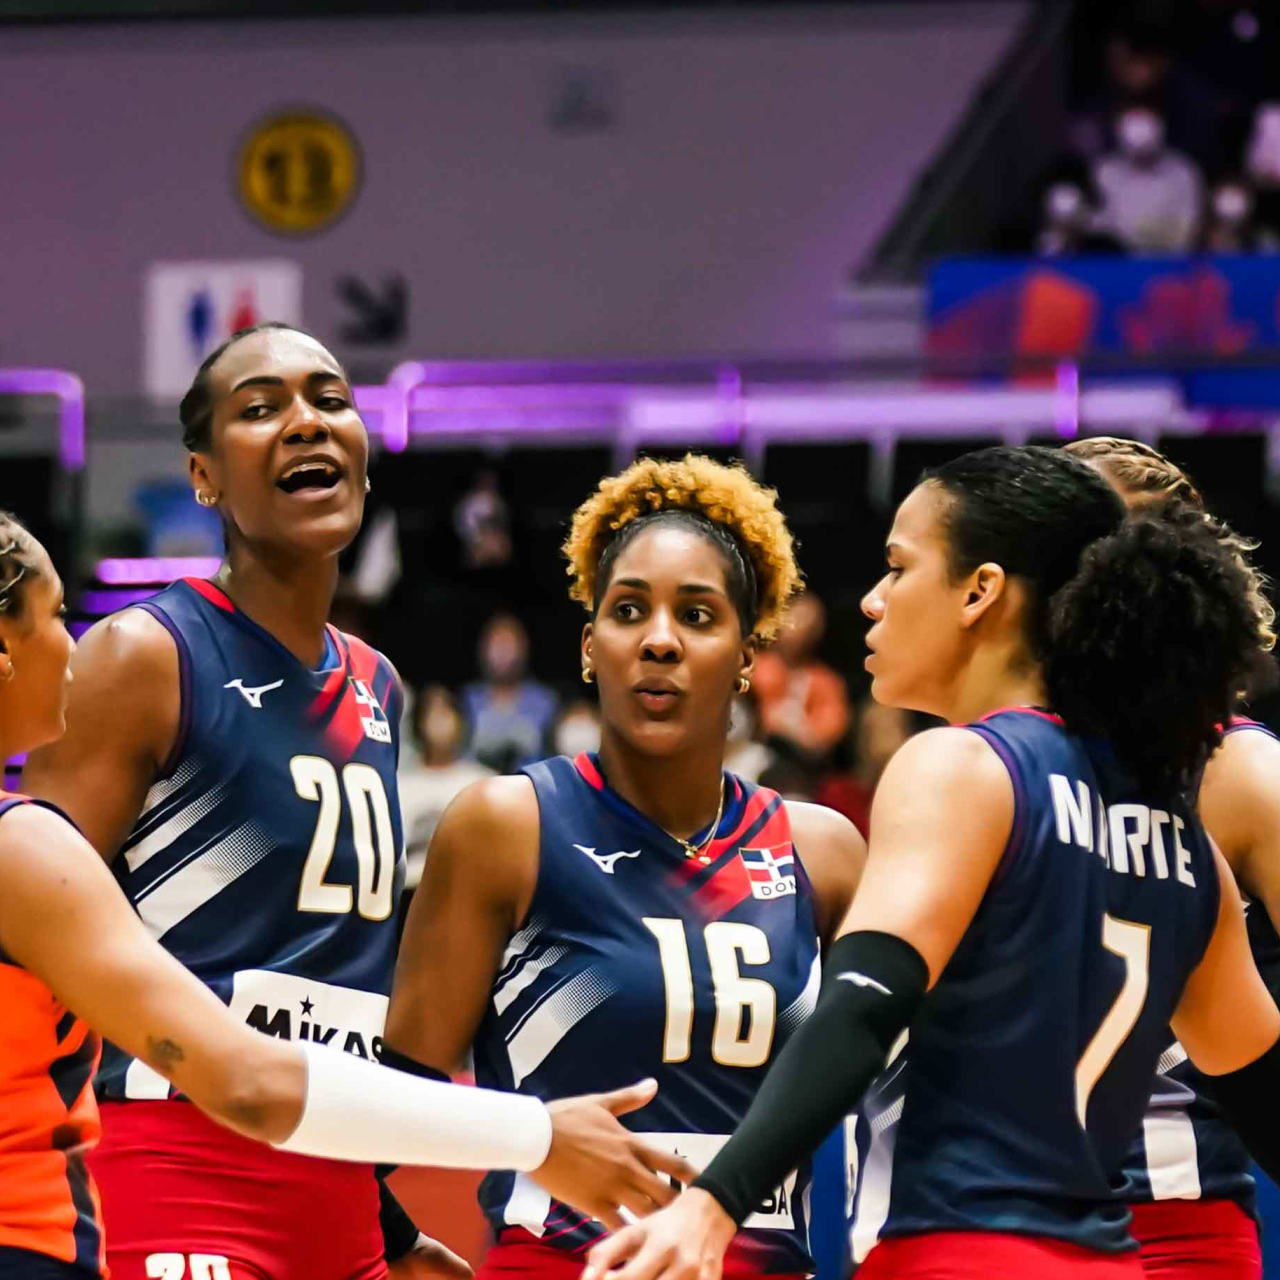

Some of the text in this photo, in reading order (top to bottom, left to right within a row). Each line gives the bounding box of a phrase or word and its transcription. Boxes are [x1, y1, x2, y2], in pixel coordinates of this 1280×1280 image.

[290, 755, 395, 921] 20
[641, 916, 777, 1068] 16
[1074, 912, 1151, 1131] 7
